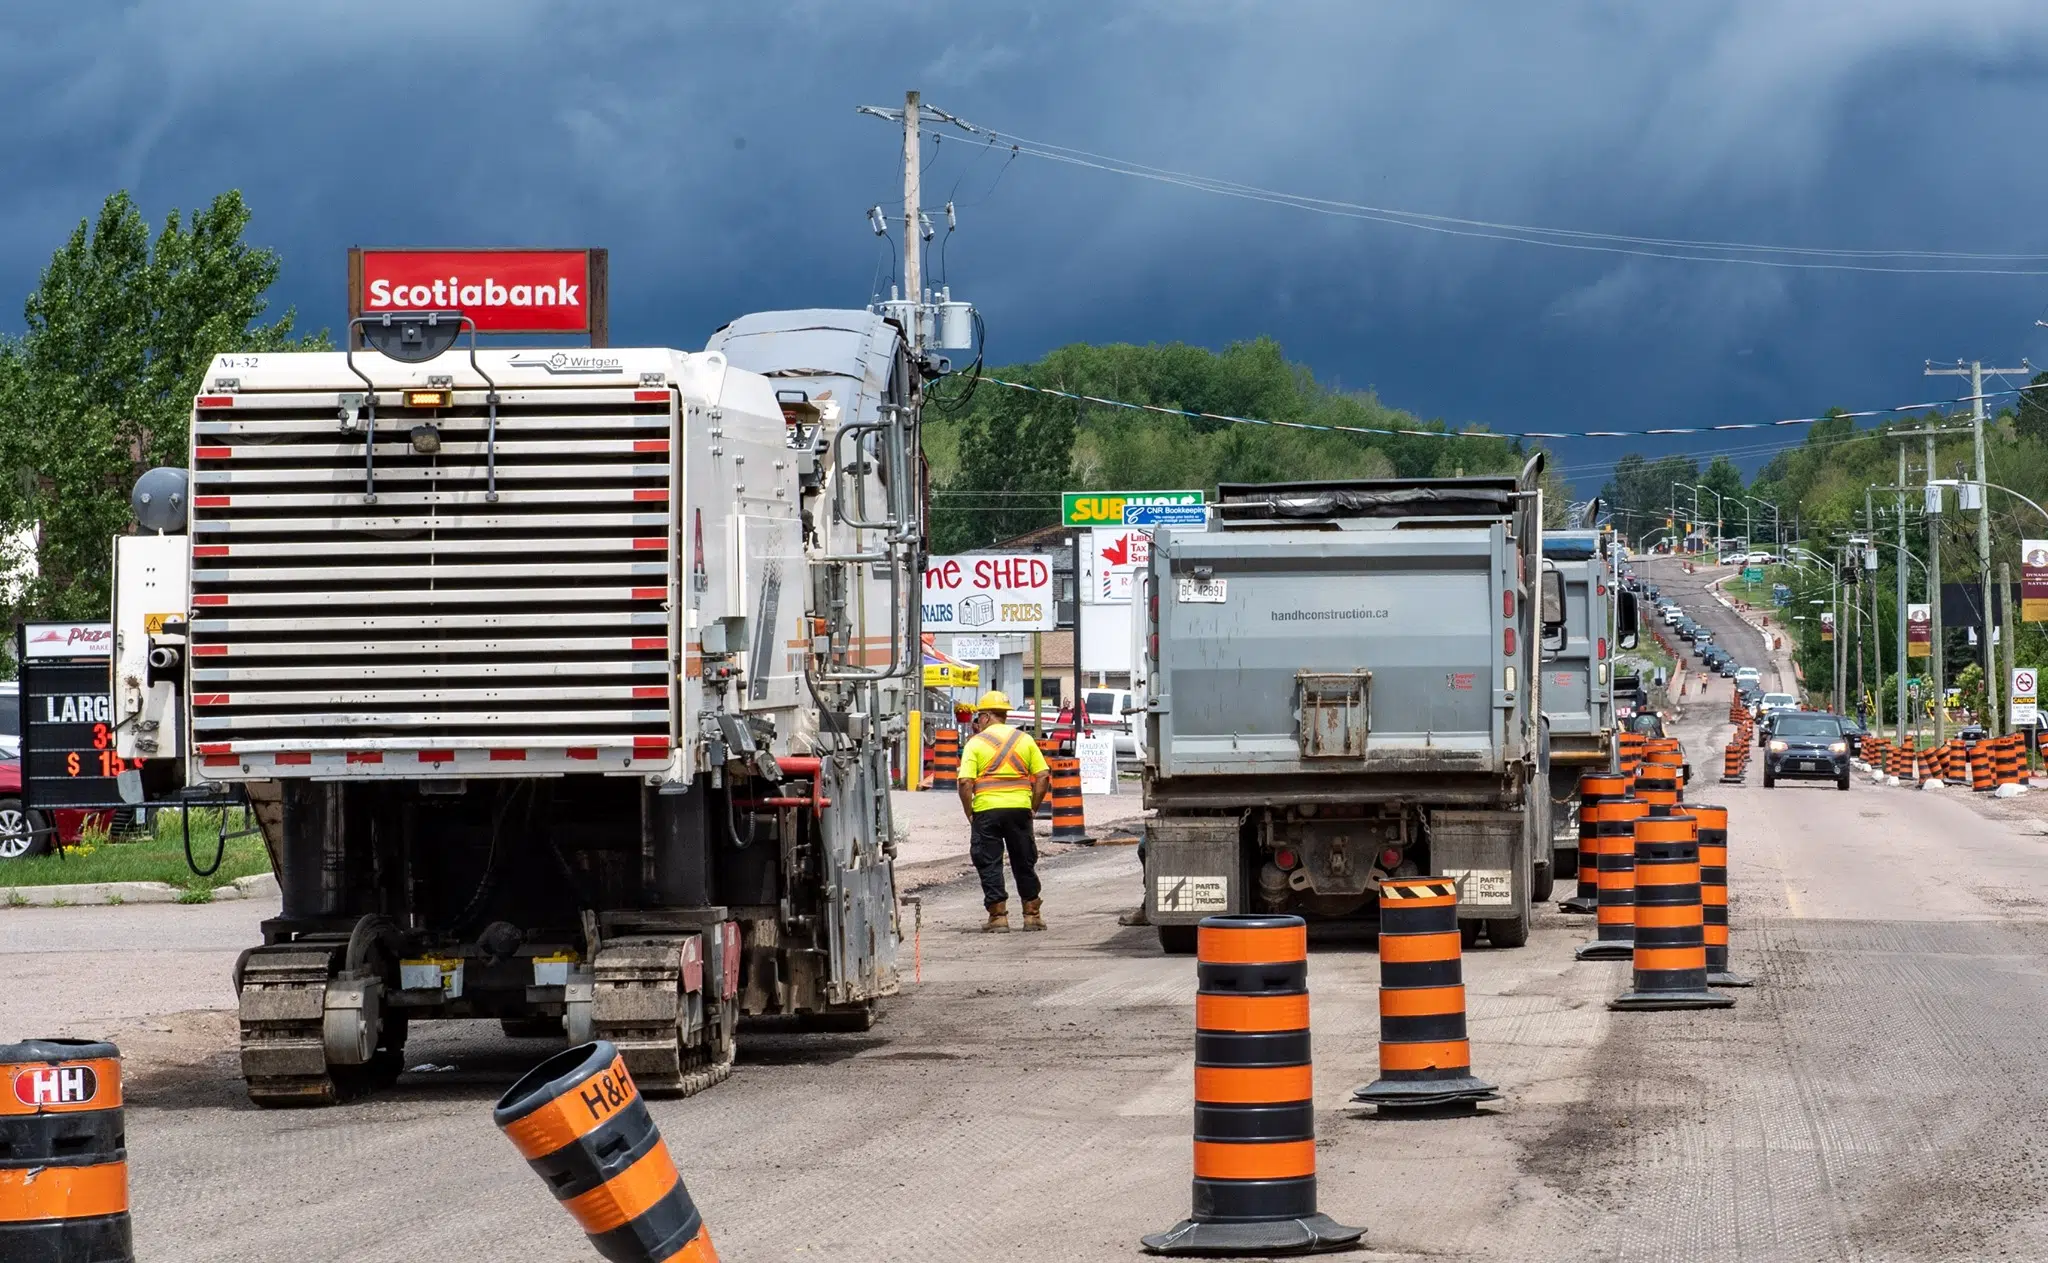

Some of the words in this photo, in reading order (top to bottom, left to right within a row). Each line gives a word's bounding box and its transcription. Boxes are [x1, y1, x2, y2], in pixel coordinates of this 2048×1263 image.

[370, 276, 579, 307] Scotiabank
[219, 357, 259, 368] M-32
[570, 356, 619, 369] Wirtgen
[1146, 506, 1163, 514] CNR
[1165, 506, 1206, 515] Bookkeeping
[1131, 543, 1147, 552] TAX
[973, 558, 1048, 590] SHED
[1181, 585, 1192, 596] BC
[1197, 585, 1223, 596] 42891
[1001, 603, 1042, 622] FRIES
[1271, 608, 1389, 621] handhconstruction.ca
[67, 628, 111, 646] Pizza
[47, 696, 112, 722] LARG
[68, 752, 80, 776] $
[33, 1068, 84, 1102] HH
[580, 1064, 634, 1120] H&H
